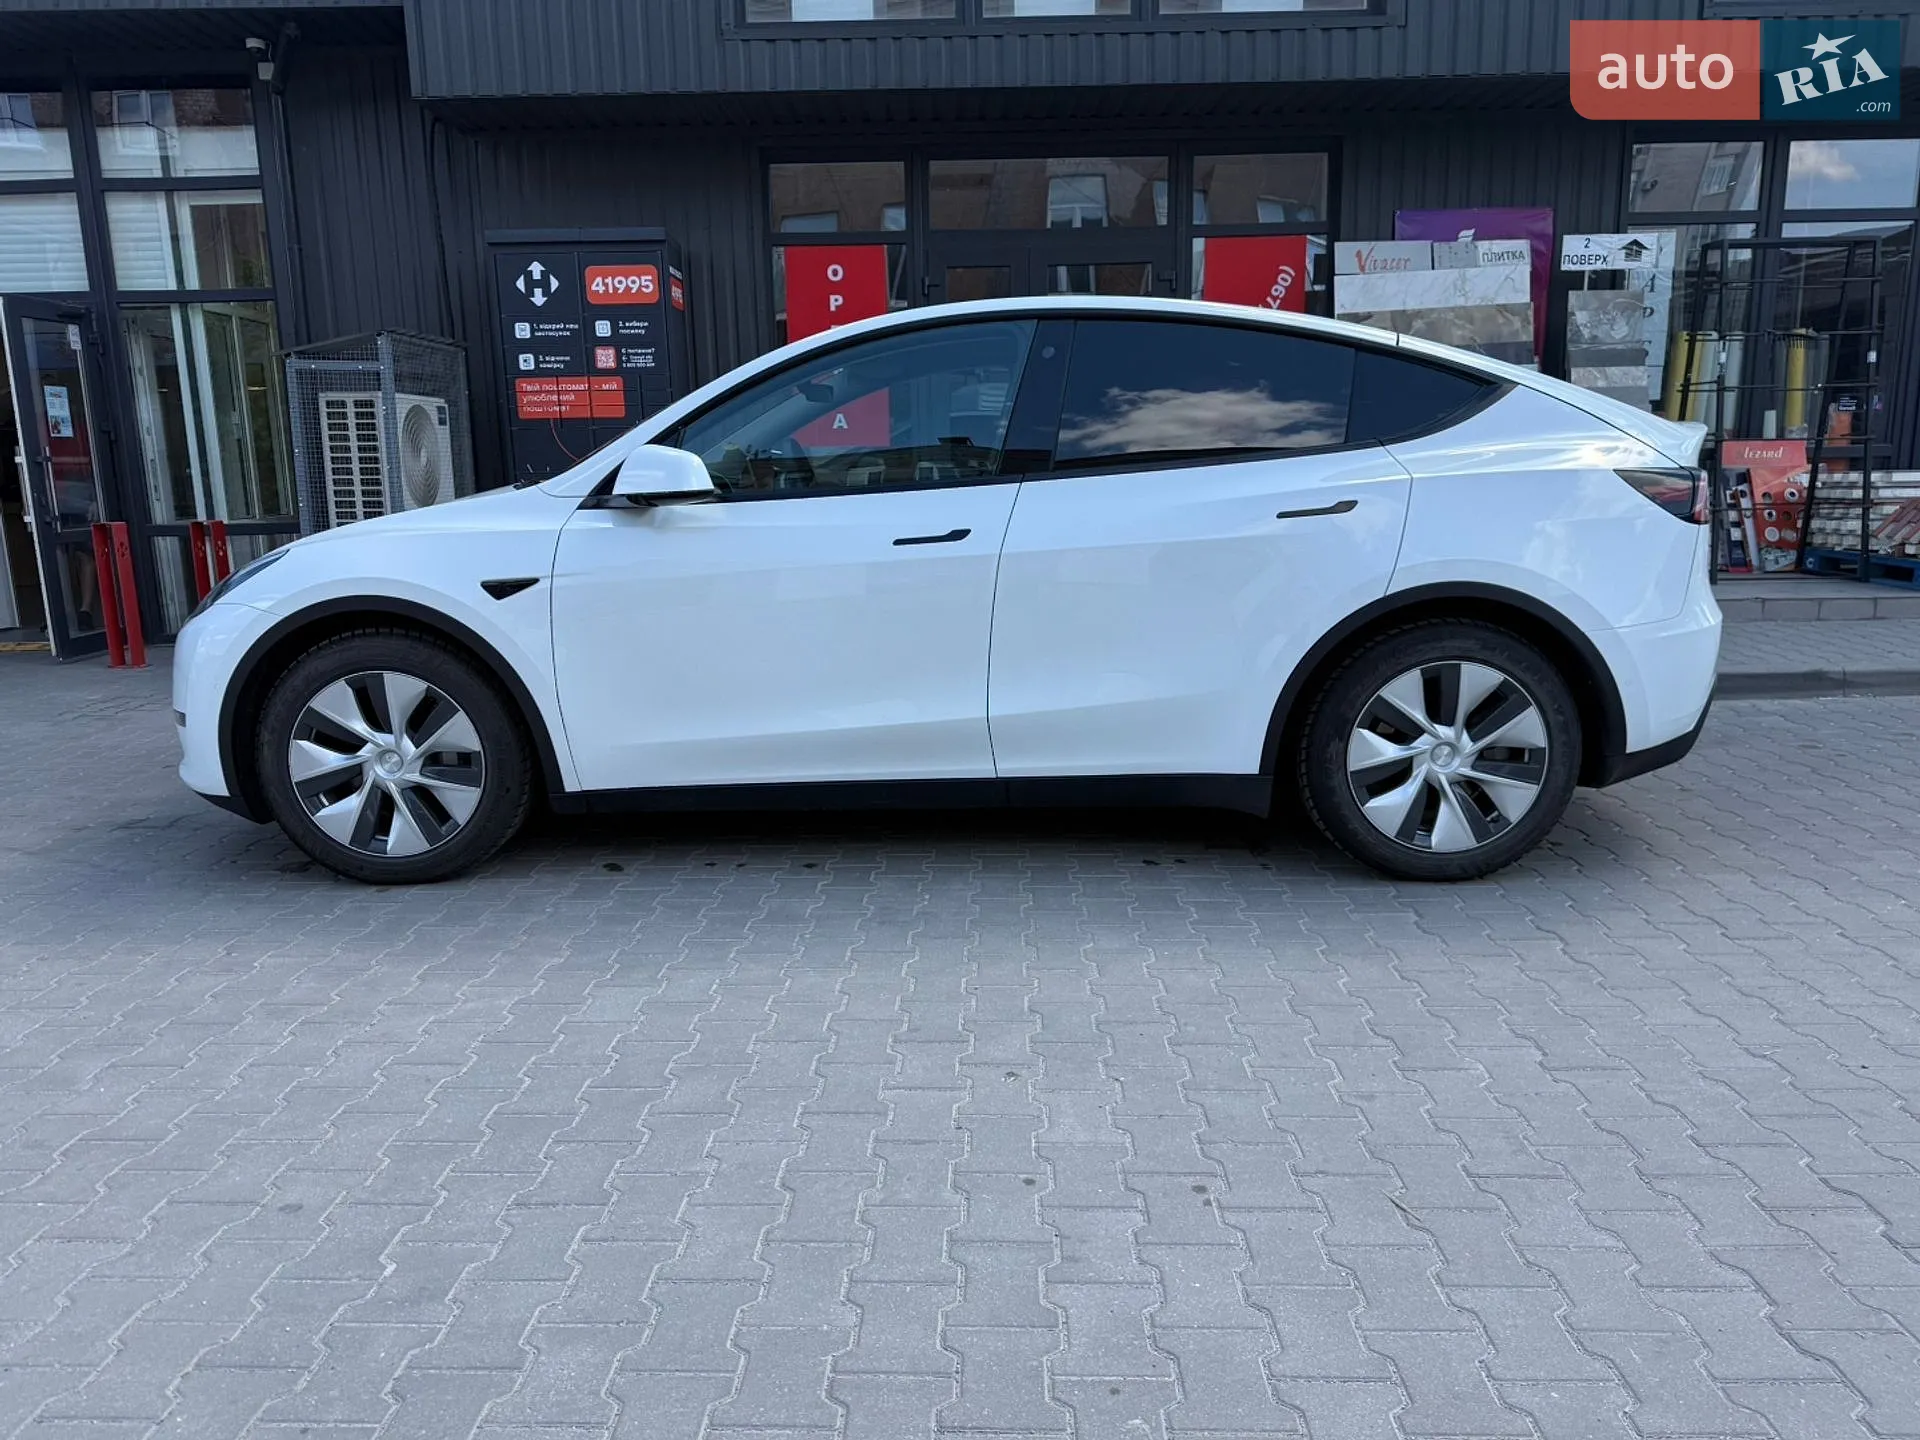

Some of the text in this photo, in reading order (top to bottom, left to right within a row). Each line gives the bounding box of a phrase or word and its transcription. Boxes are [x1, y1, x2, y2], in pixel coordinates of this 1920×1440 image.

[1584, 237, 1591, 249] 2
[1481, 249, 1526, 263] ПЛИТКА
[1562, 254, 1609, 266] ПОВЕРХ
[591, 275, 654, 294] 41995
